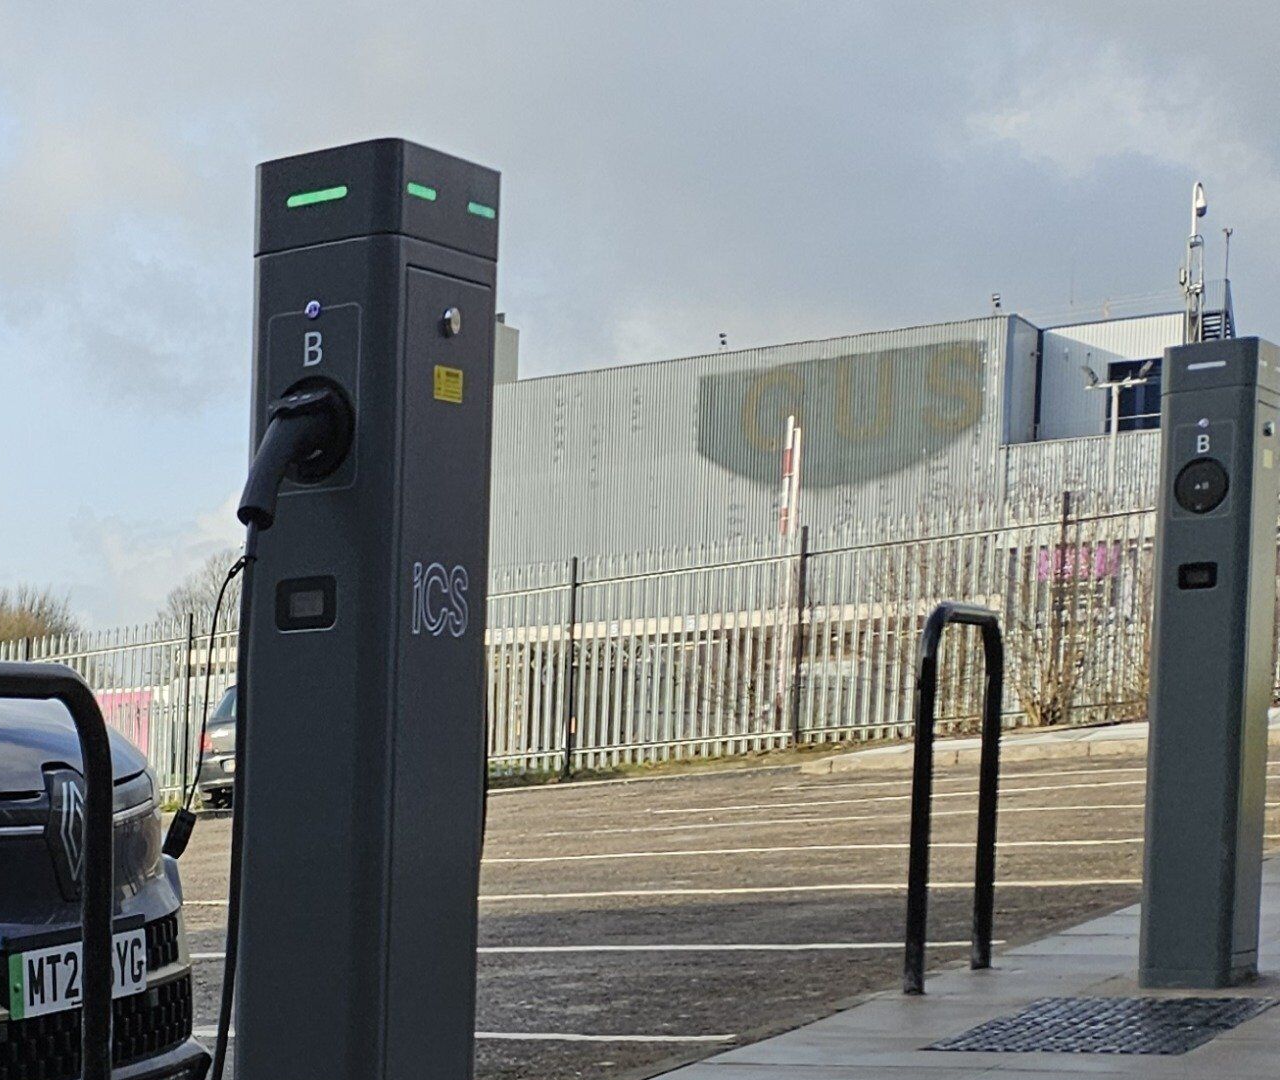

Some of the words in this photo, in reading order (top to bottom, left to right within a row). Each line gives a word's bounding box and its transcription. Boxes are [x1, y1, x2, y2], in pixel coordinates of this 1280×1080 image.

[303, 331, 323, 367] B
[742, 340, 984, 450] GUS
[1197, 434, 1210, 453] B
[27, 951, 80, 1007] MT2
[110, 938, 144, 987] YG
